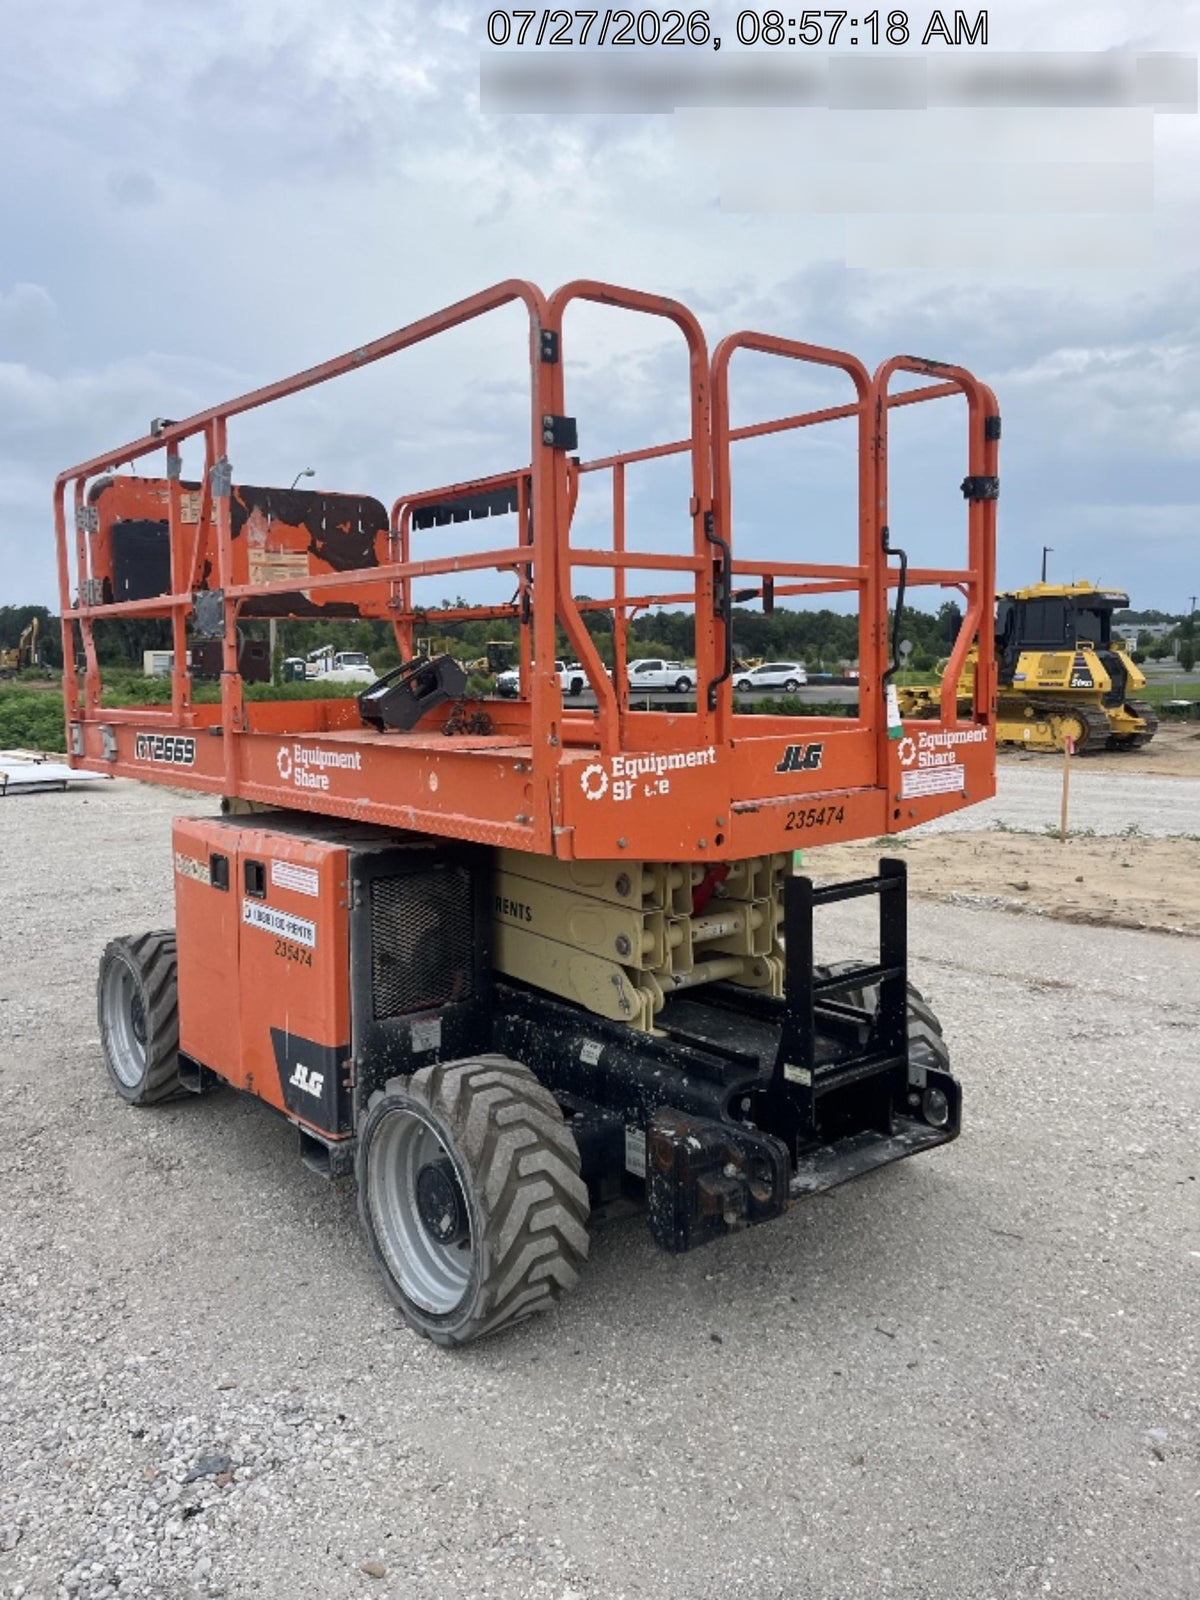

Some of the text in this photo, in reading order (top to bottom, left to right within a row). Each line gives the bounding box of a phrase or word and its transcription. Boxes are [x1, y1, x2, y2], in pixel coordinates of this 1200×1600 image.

[135, 732, 196, 766] RT2669
[918, 727, 988, 751] Equipment
[293, 744, 362, 771] Equipment
[611, 746, 716, 780] Equipment
[775, 742, 825, 774] JLG
[918, 751, 956, 768] Share
[293, 767, 330, 791] Share
[785, 806, 845, 831] 235474
[495, 896, 533, 922] RENTS
[274, 940, 312, 968] 235474
[289, 1062, 325, 1099] JLG
